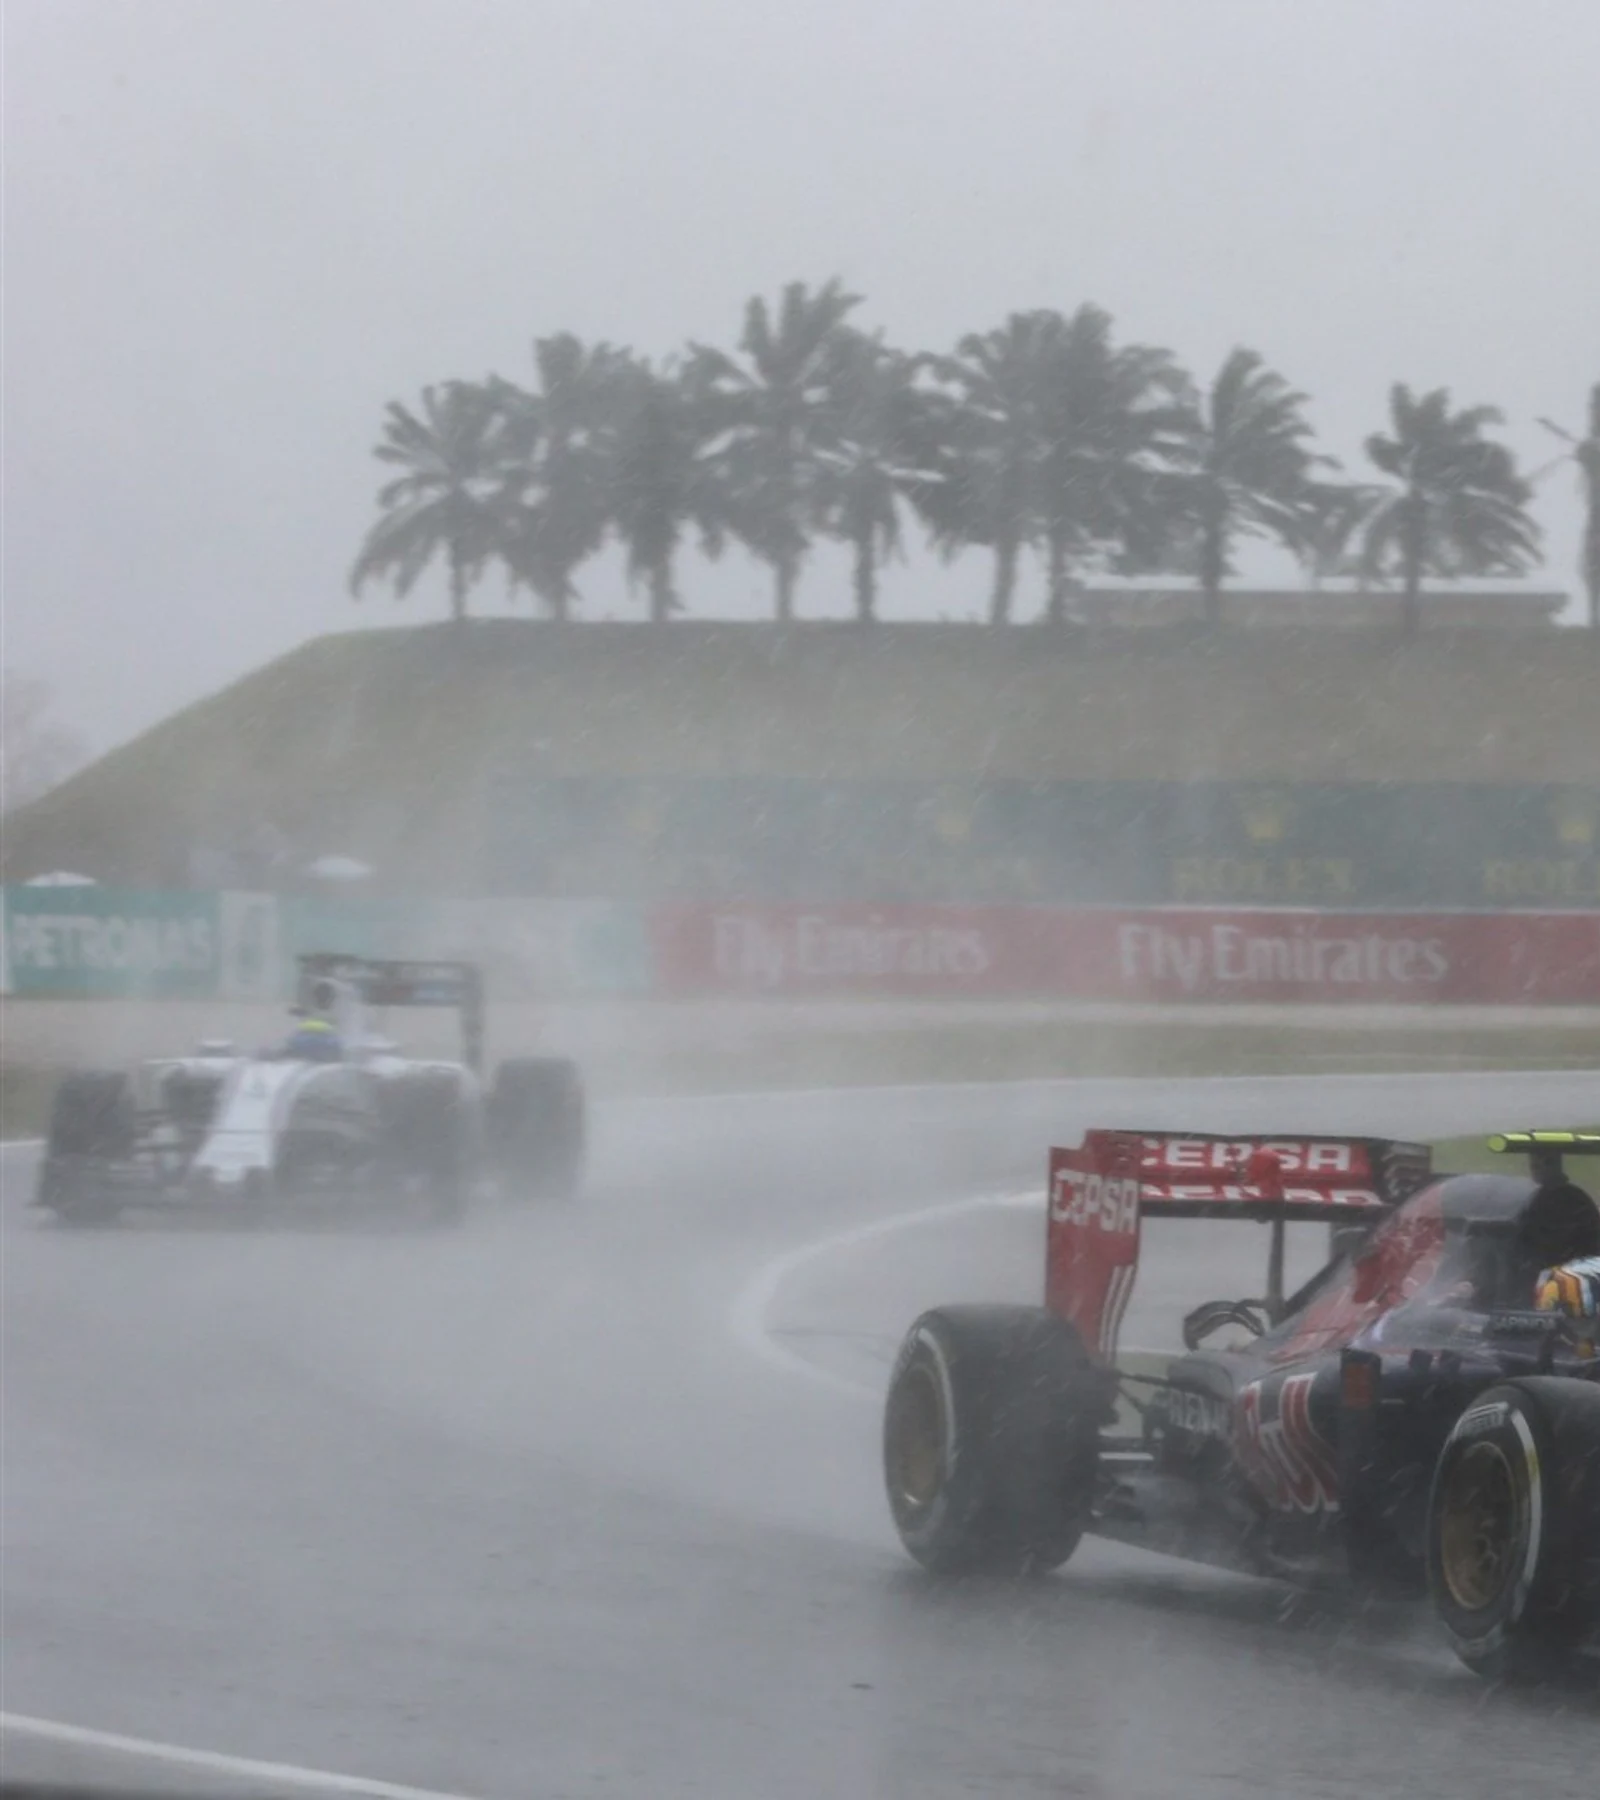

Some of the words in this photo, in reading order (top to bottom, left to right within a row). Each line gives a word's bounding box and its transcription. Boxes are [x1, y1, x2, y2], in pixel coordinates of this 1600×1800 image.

[13, 915, 210, 970] PETRONAS
[1117, 922, 1208, 991] Fly
[1212, 918, 1447, 983] Emirates
